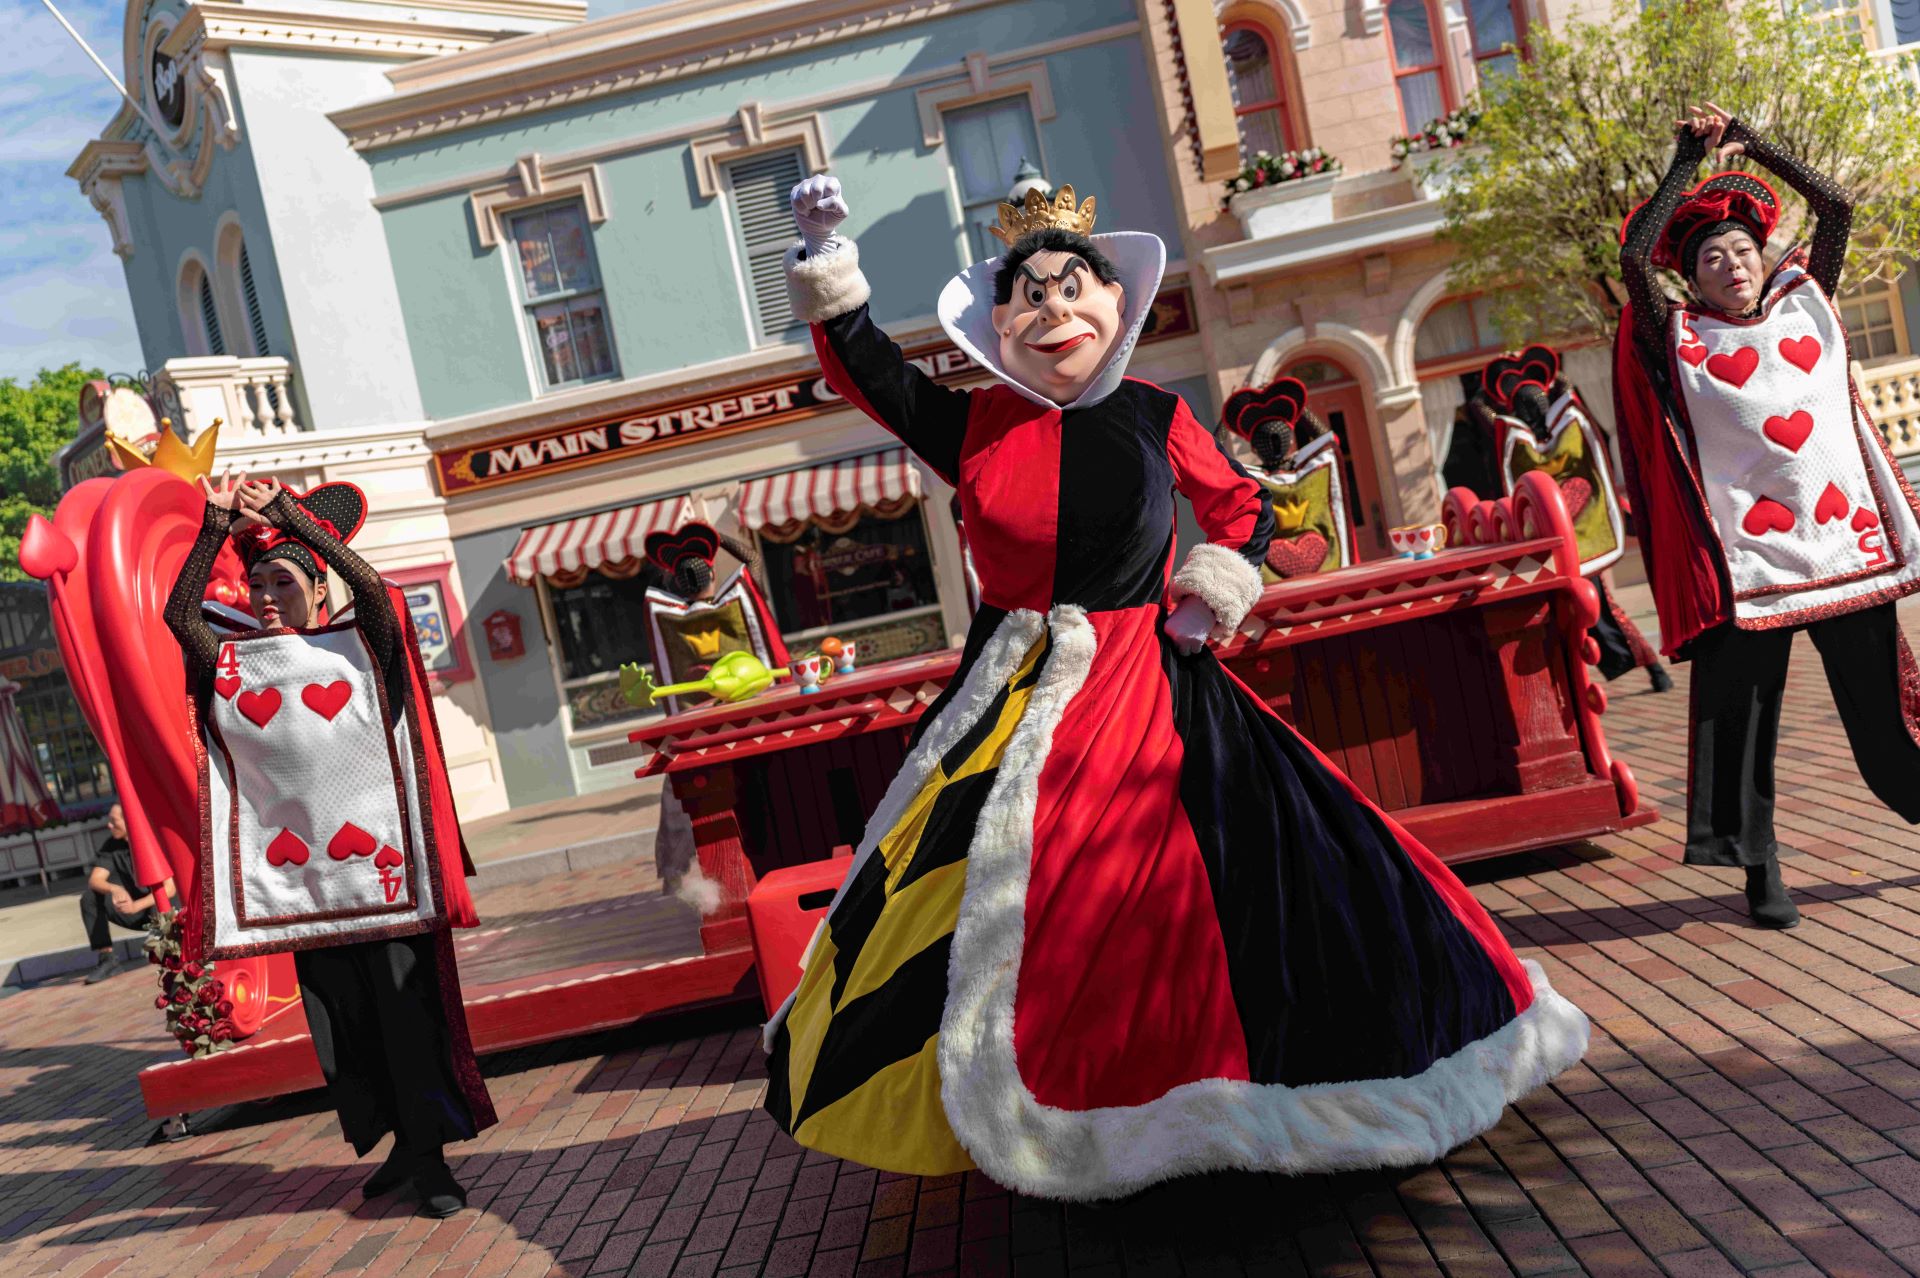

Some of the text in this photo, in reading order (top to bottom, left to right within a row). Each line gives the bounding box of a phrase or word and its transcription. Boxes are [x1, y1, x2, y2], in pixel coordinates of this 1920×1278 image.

[1681, 312, 1700, 345] 5
[487, 427, 609, 476] MAIN
[619, 384, 800, 445] STREET
[1858, 530, 1888, 567] 5
[216, 642, 241, 676] 4
[378, 869, 402, 903] 4
